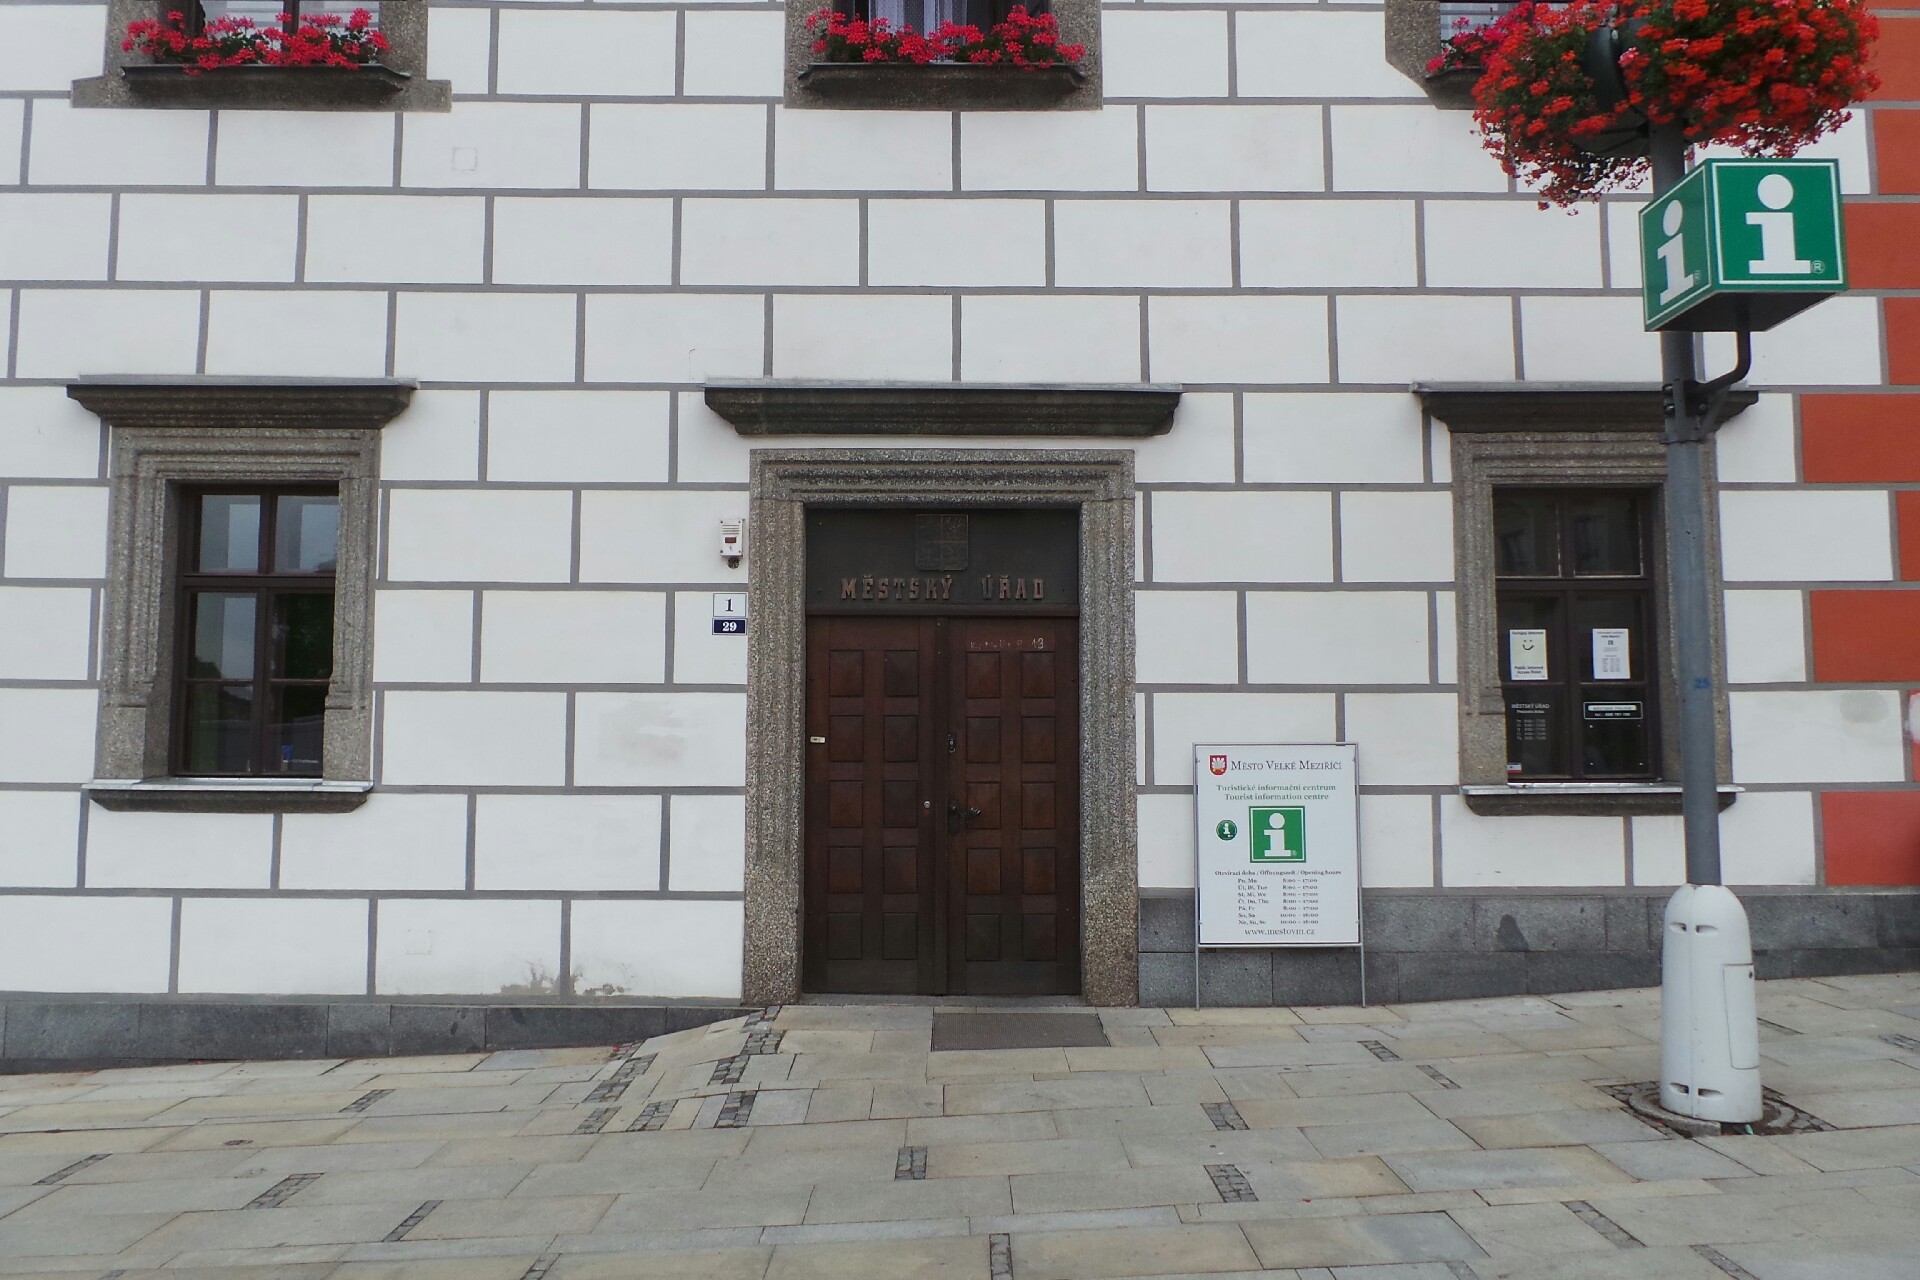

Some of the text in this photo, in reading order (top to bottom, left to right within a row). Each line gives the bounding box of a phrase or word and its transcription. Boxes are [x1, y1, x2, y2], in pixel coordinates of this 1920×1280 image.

[841, 574, 1045, 600] MĚSTSKÝ ÚŘAD
[725, 598, 733, 612] 1
[722, 621, 737, 632] 29
[1257, 783, 1301, 791] informační
[1224, 793, 1329, 801] Tourist information centre
